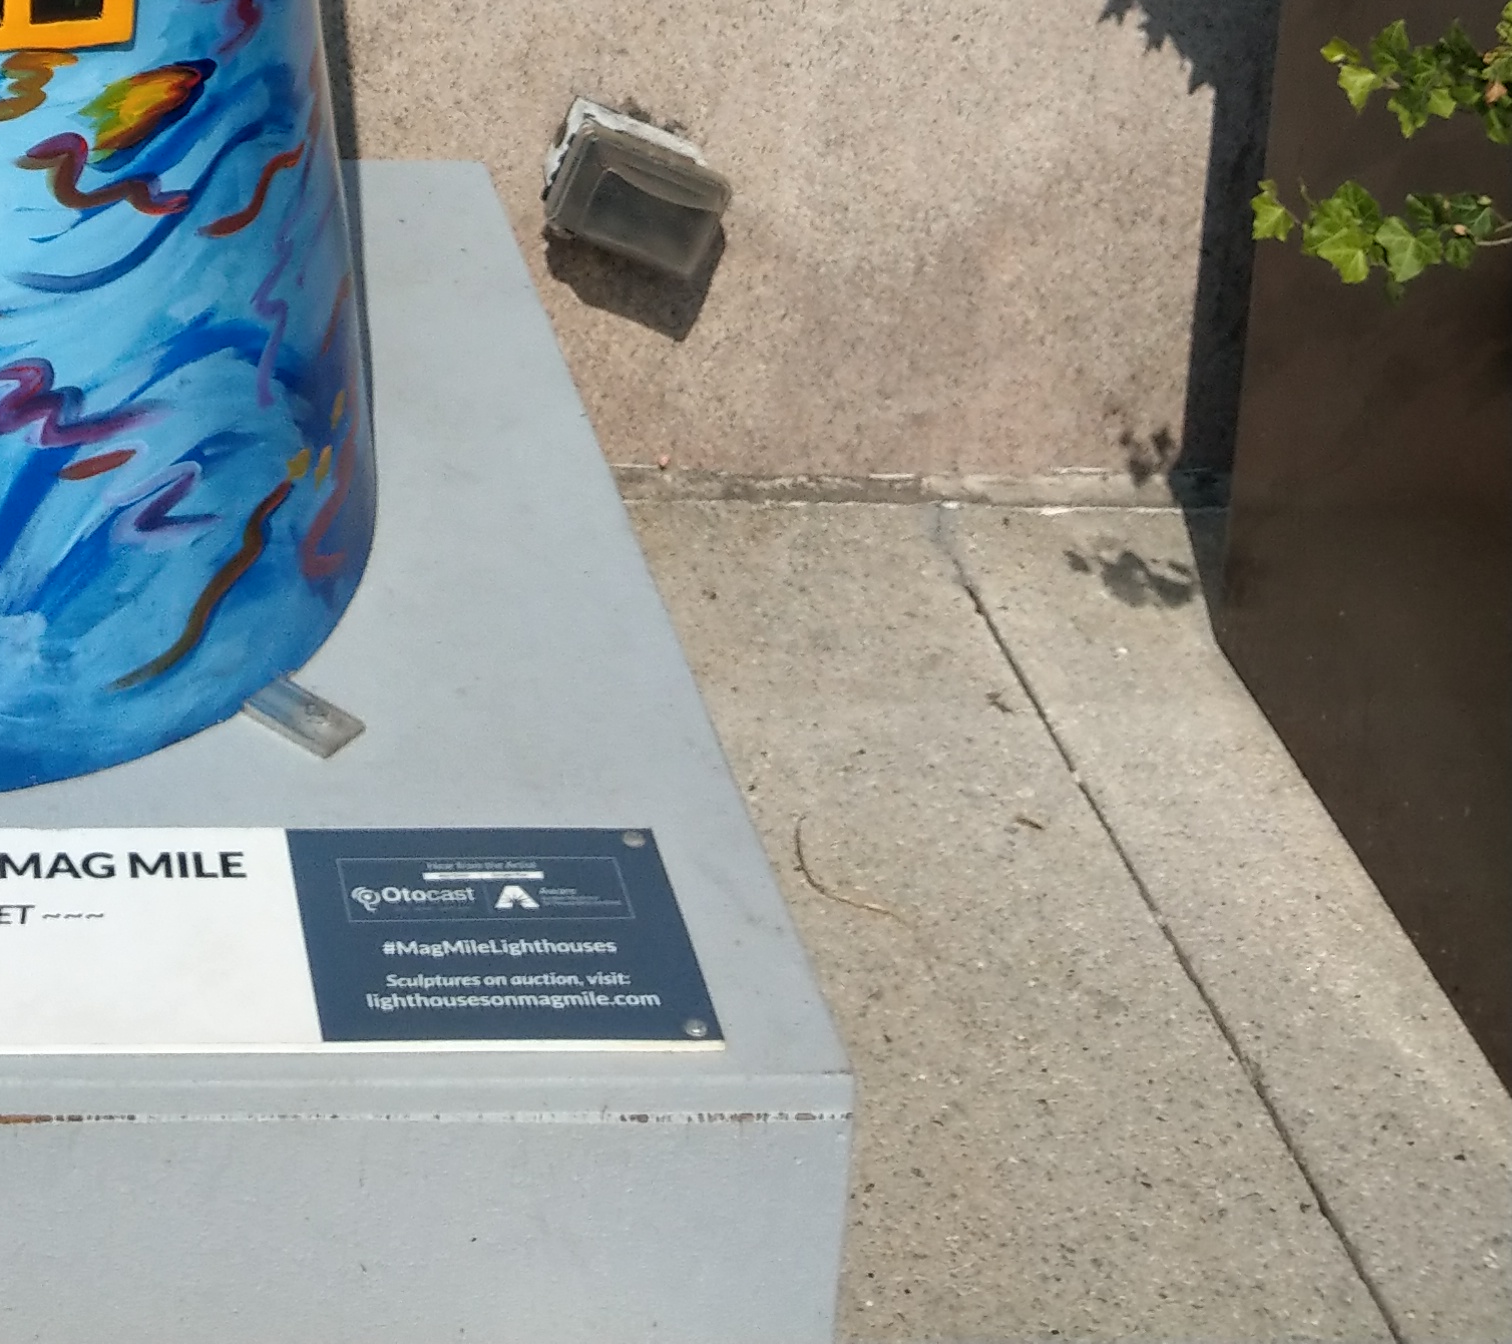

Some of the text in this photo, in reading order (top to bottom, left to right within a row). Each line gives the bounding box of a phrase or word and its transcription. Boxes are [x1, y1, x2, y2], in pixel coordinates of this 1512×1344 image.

[129, 851, 247, 878] MILE
[382, 887, 475, 902] Otocast
[382, 938, 618, 957] #MagMileLighthouses
[386, 971, 631, 989] Sculptures on auction, visit:
[366, 992, 661, 1011] lighthousesonmagmile.com
